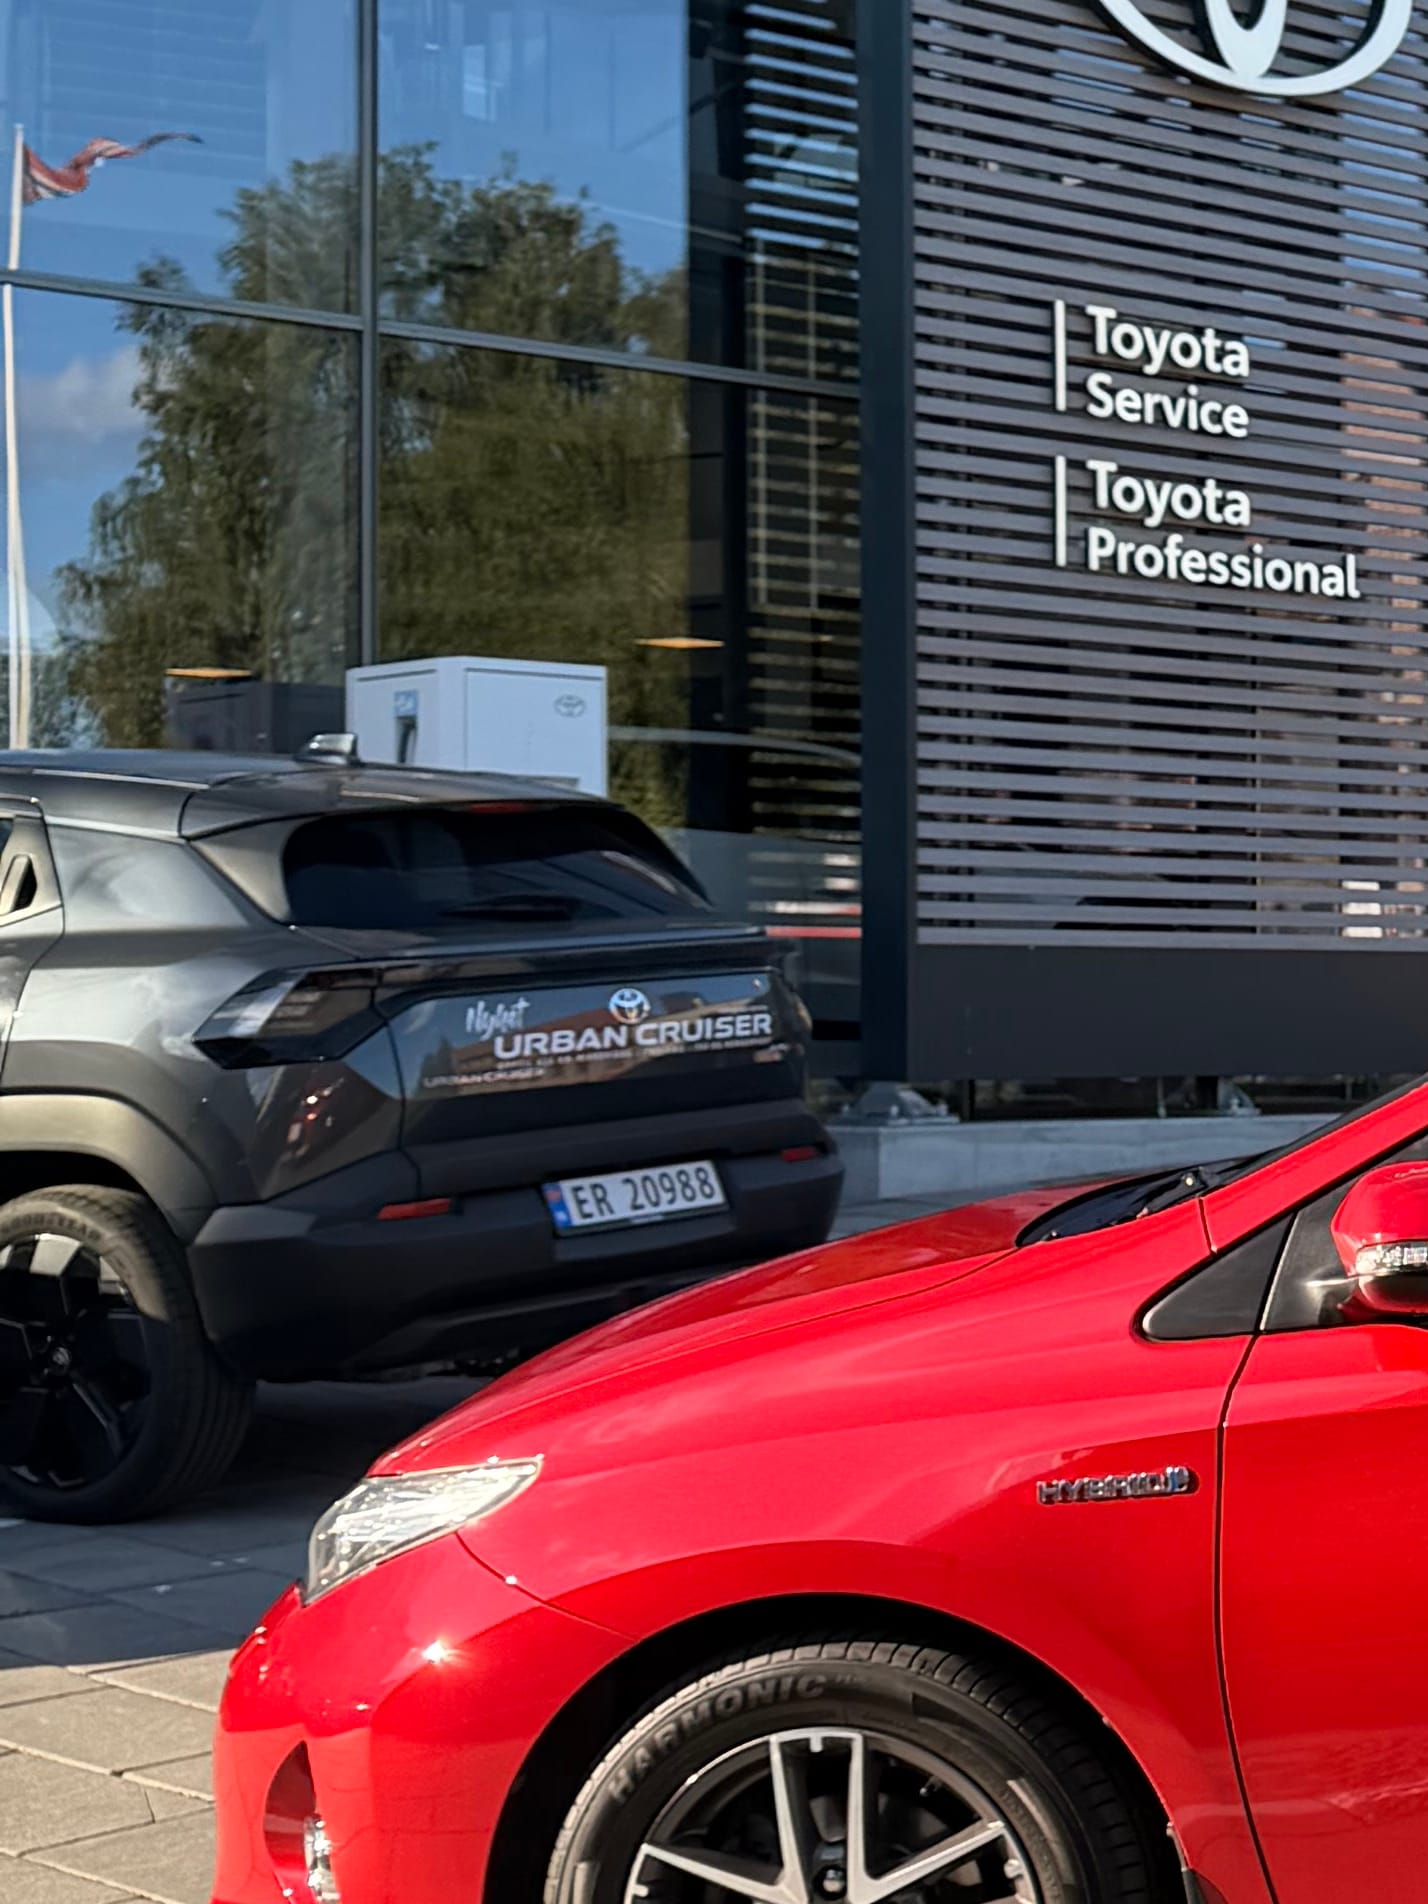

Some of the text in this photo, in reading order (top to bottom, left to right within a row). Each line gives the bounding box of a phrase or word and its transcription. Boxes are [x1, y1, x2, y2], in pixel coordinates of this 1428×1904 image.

[1084, 304, 1251, 378] Toyota
[1086, 371, 1250, 439] Service
[1085, 458, 1251, 528] Toyota
[1087, 526, 1362, 599] Professional
[493, 1024, 628, 1060] URBAN
[635, 1013, 773, 1048] CRUISER
[570, 1166, 717, 1221] ER 20988
[607, 1673, 828, 1804] HARMONIC
